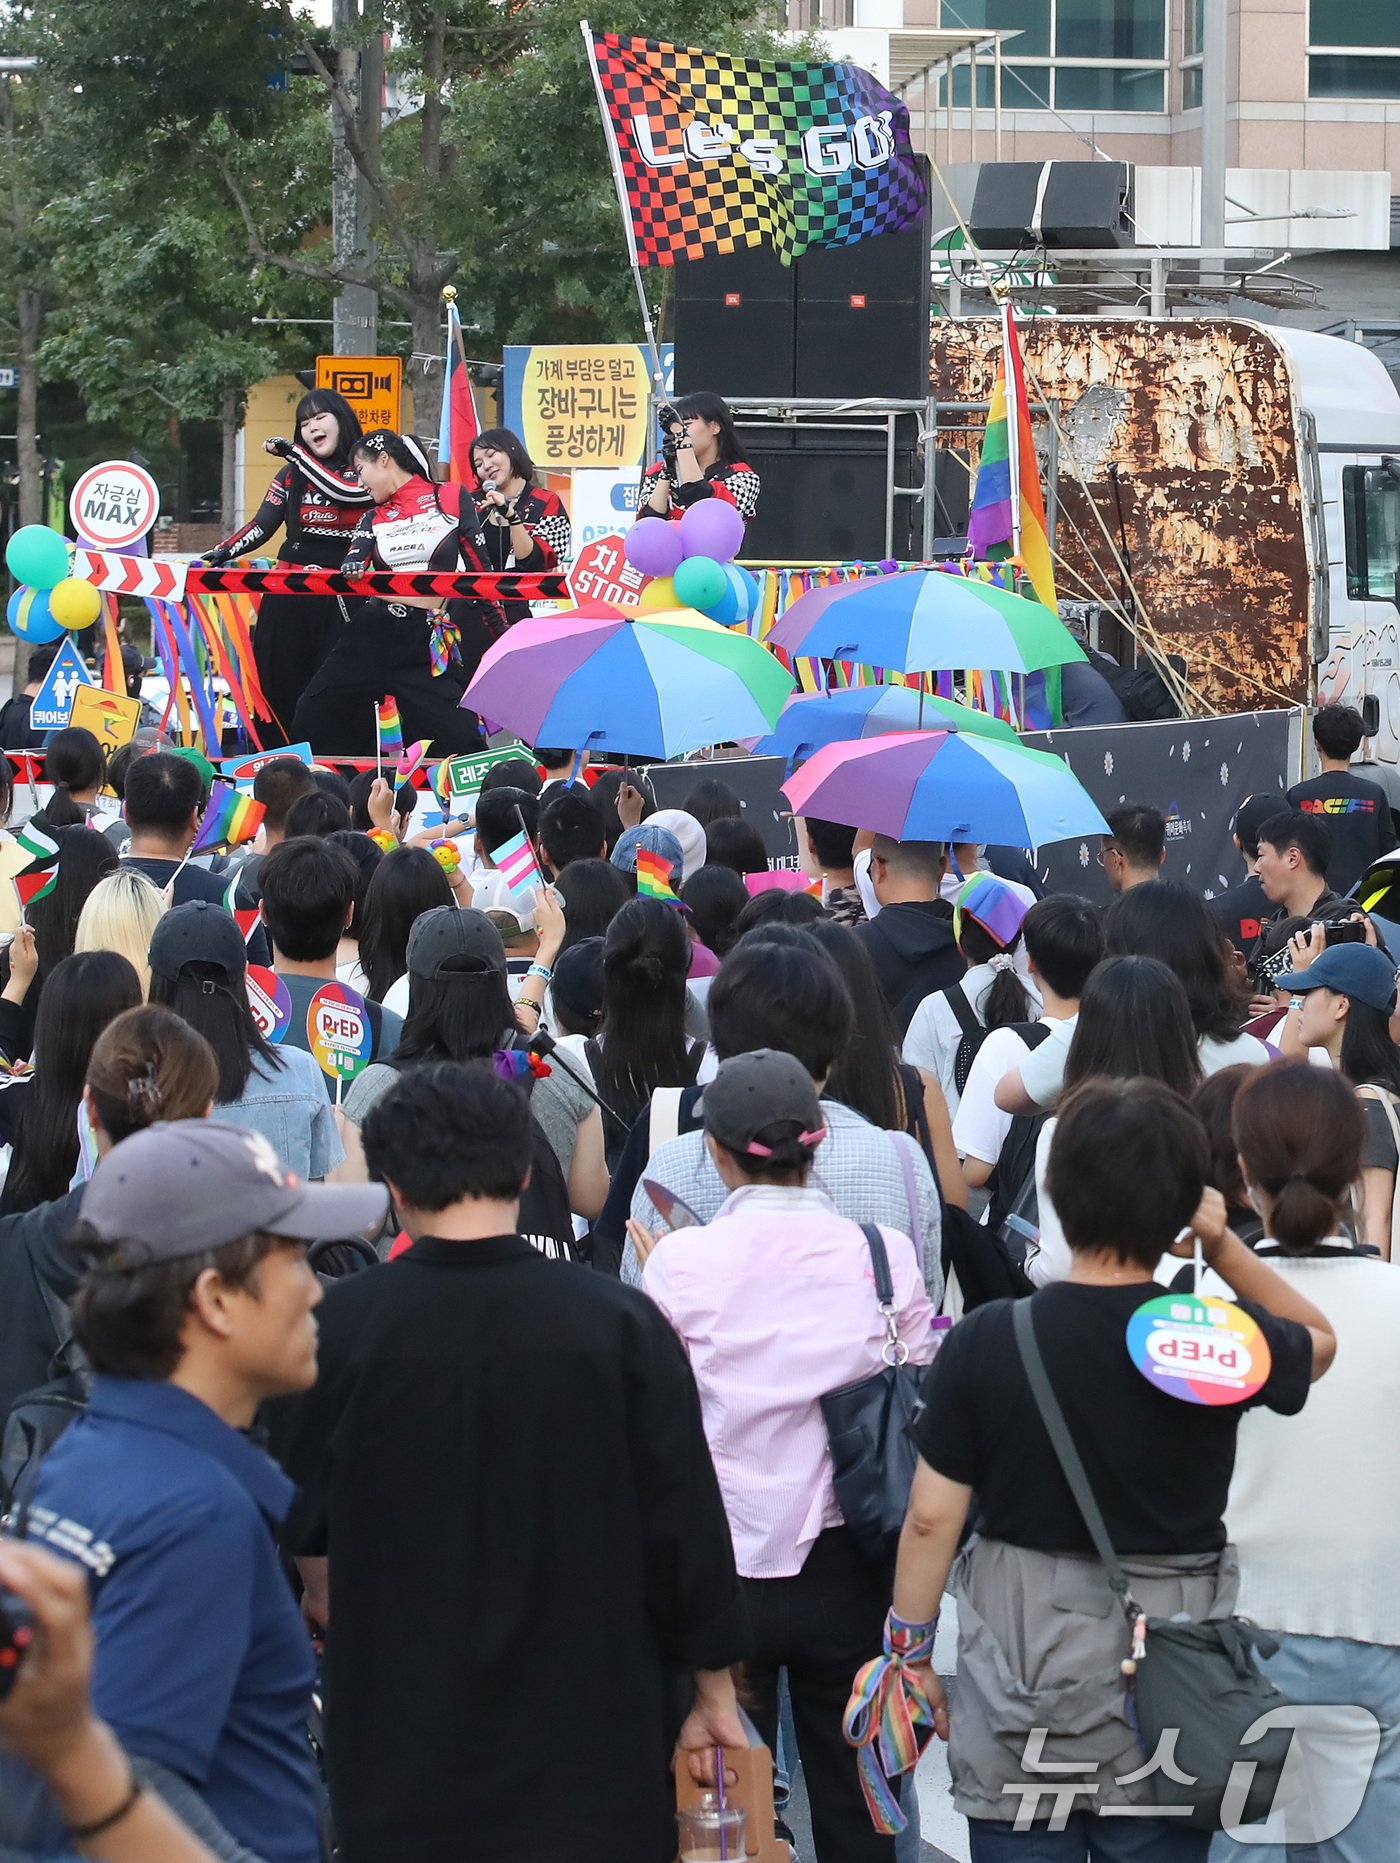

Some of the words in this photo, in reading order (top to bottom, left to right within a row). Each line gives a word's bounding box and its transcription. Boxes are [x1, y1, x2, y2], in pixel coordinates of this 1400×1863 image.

[800, 110, 896, 178] GO!
[537, 359, 563, 381] 가계
[566, 359, 605, 382] 부담은
[608, 359, 636, 381] 덜고
[537, 387, 637, 420] 장바구니는
[546, 424, 625, 458] 풍성하게
[93, 483, 141, 505] 자긍심
[83, 499, 141, 526] MAX
[574, 569, 640, 606] STOP
[322, 1013, 359, 1039] PrEP
[1158, 1339, 1237, 1368] PrEP
